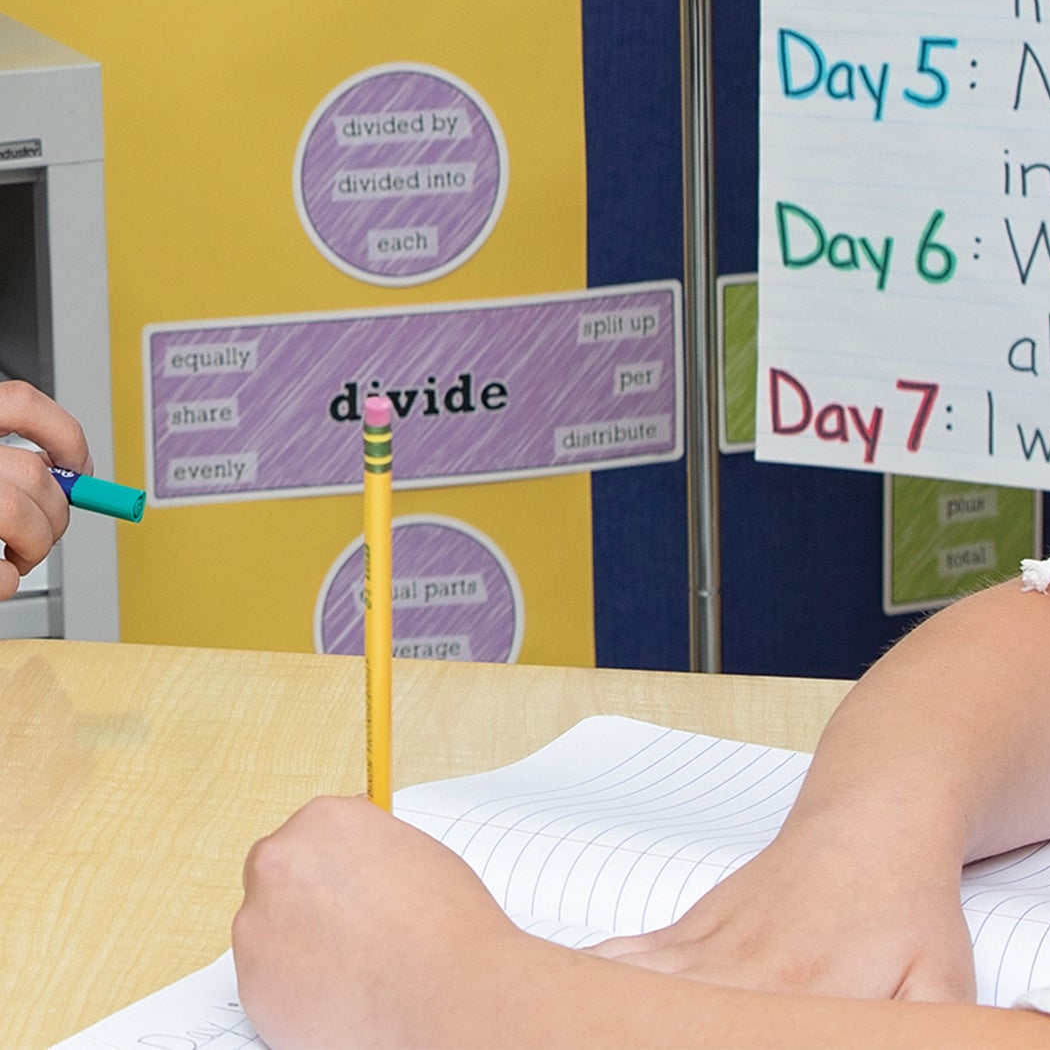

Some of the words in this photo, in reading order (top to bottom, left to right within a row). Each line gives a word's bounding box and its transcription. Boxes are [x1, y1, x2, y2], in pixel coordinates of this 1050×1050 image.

[777, 27, 891, 123] Day
[342, 113, 422, 140] divided
[431, 112, 459, 138] by
[337, 169, 420, 196] divided
[426, 167, 467, 191] into
[377, 231, 429, 254] each
[775, 201, 895, 292] Day
[581, 312, 624, 339] split
[629, 313, 657, 338] up
[171, 345, 251, 373] equally
[619, 366, 654, 391] per
[328, 373, 510, 424] dvide
[171, 403, 232, 425] share
[768, 367, 884, 465] Day
[986, 389, 996, 457] I
[561, 421, 657, 451] distribute
[174, 457, 247, 484] evenly
[946, 497, 986, 519] plus
[946, 546, 986, 568] total
[424, 578, 478, 603] parts
[391, 640, 461, 662] verage
